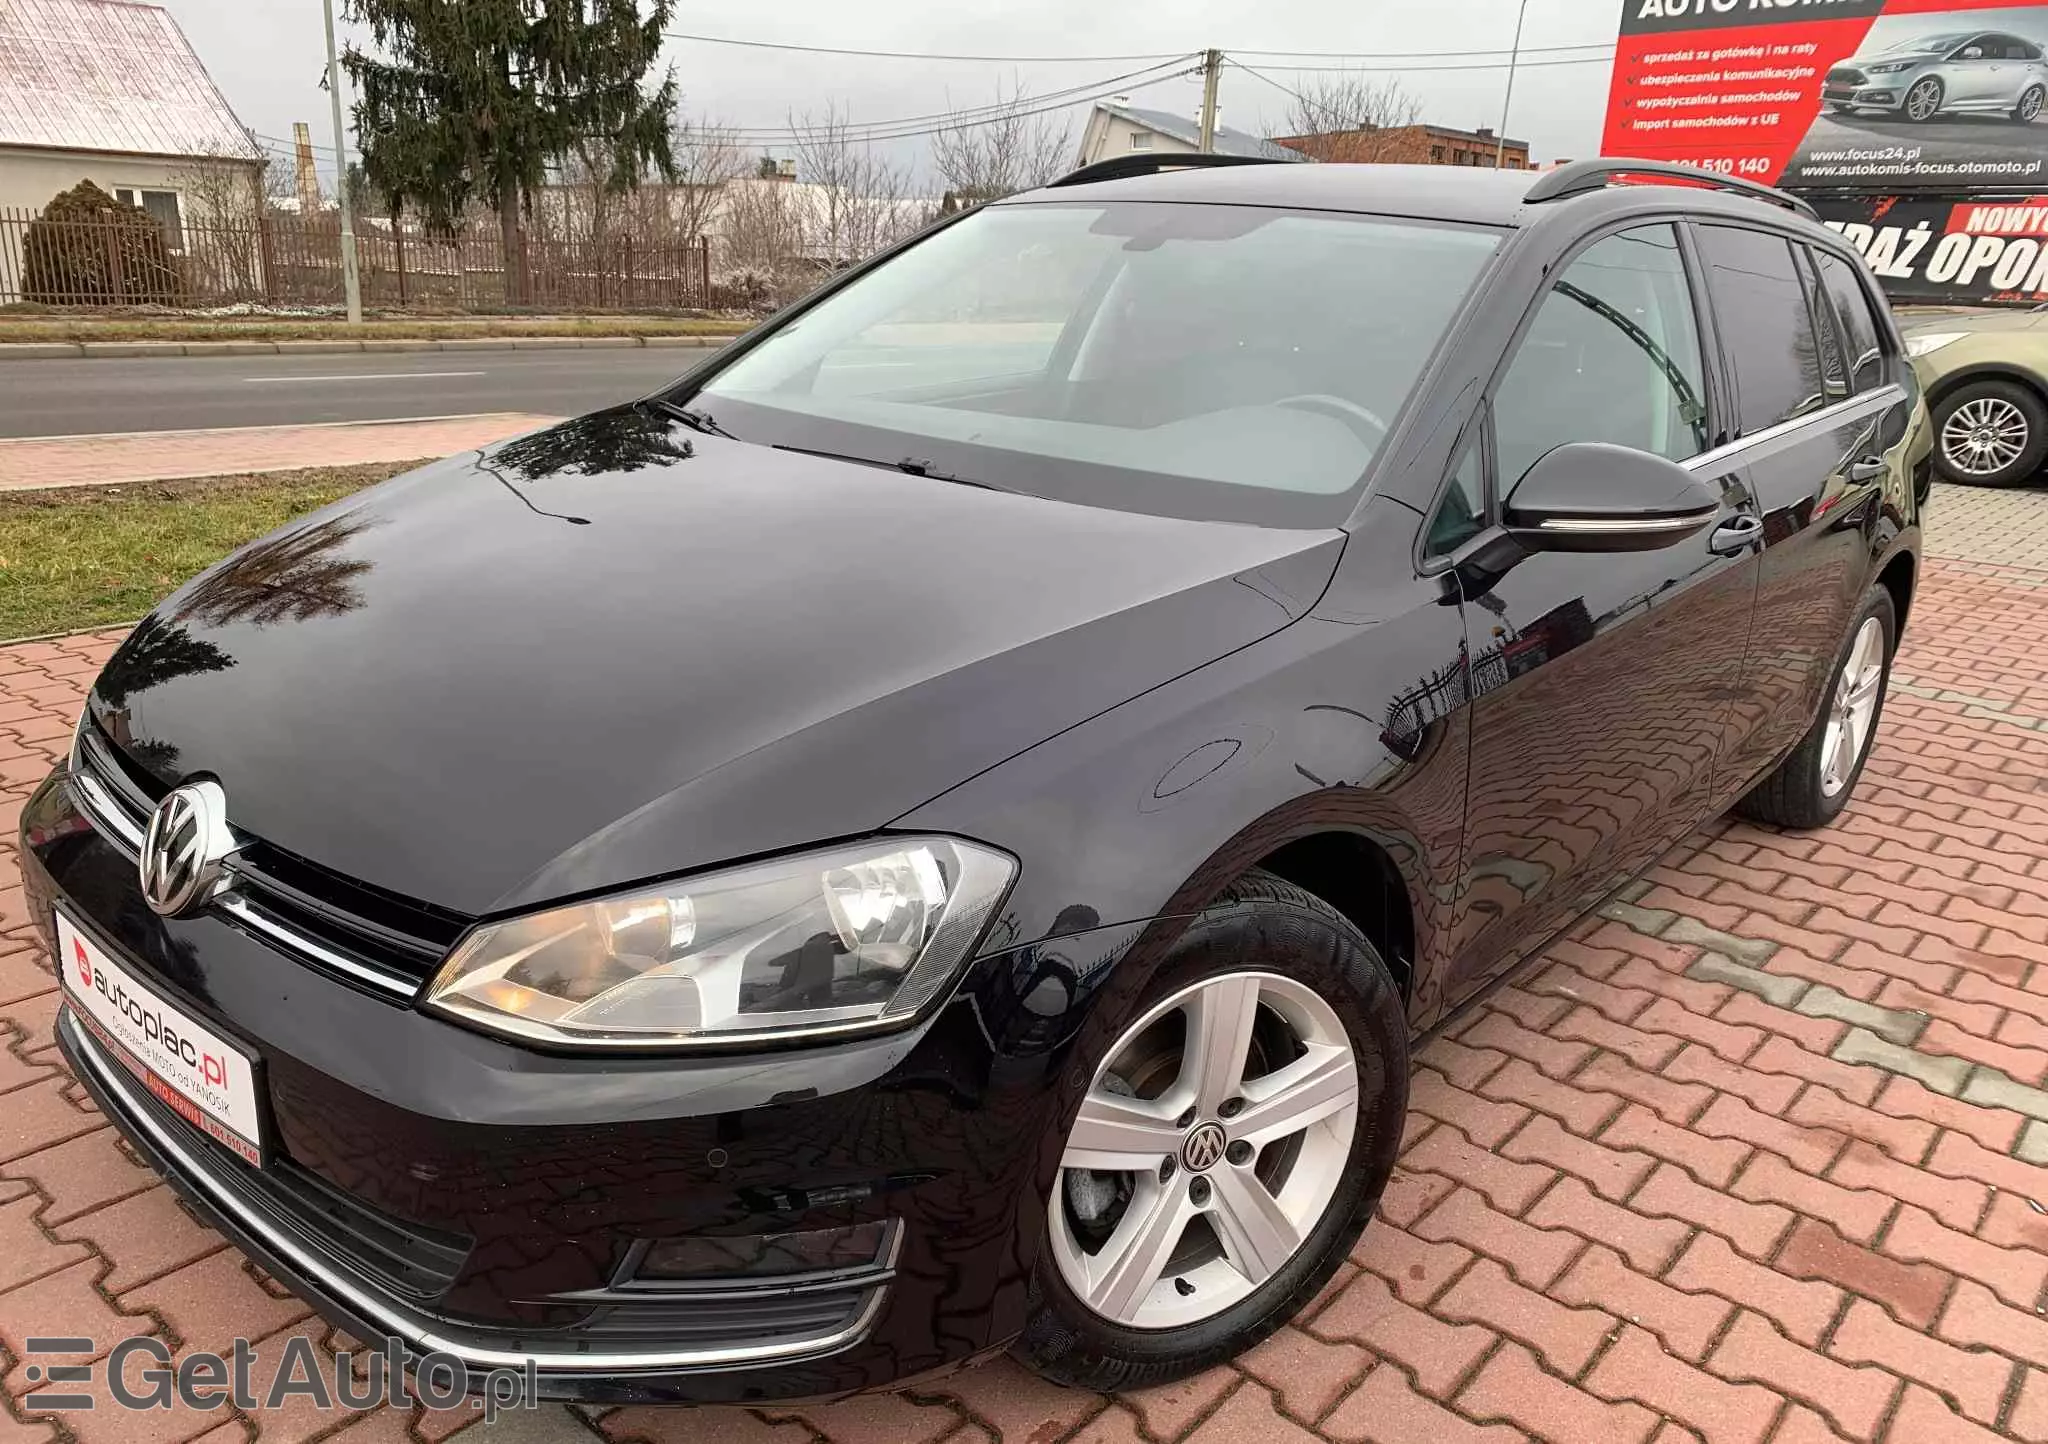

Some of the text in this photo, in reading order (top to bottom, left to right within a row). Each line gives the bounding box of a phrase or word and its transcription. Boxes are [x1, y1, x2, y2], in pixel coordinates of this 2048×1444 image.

[1643, 49, 1694, 64] sprzedaż
[1696, 50, 1710, 60] za
[1711, 45, 1764, 62] gotówkę
[1773, 45, 1789, 56] na
[1791, 42, 1818, 56] raty
[1640, 65, 1816, 87] ubezpieczenia komunikacyjne
[1636, 90, 1802, 109] wypożyczalnia samochodów
[1671, 114, 1749, 127] samochodów
[1760, 112, 1780, 125] UE
[1702, 158, 1734, 174] 510
[1738, 157, 1770, 174] 140
[1810, 147, 1920, 162] www.focus24.pl
[1801, 160, 2041, 177] www.autokomis-focus.otomoto.pl
[1965, 207, 2048, 233] NOWY
[1823, 220, 1933, 279] DAŻ
[94, 967, 228, 1090] autoplac.pl
[190, 1079, 231, 1117] YANOSIK
